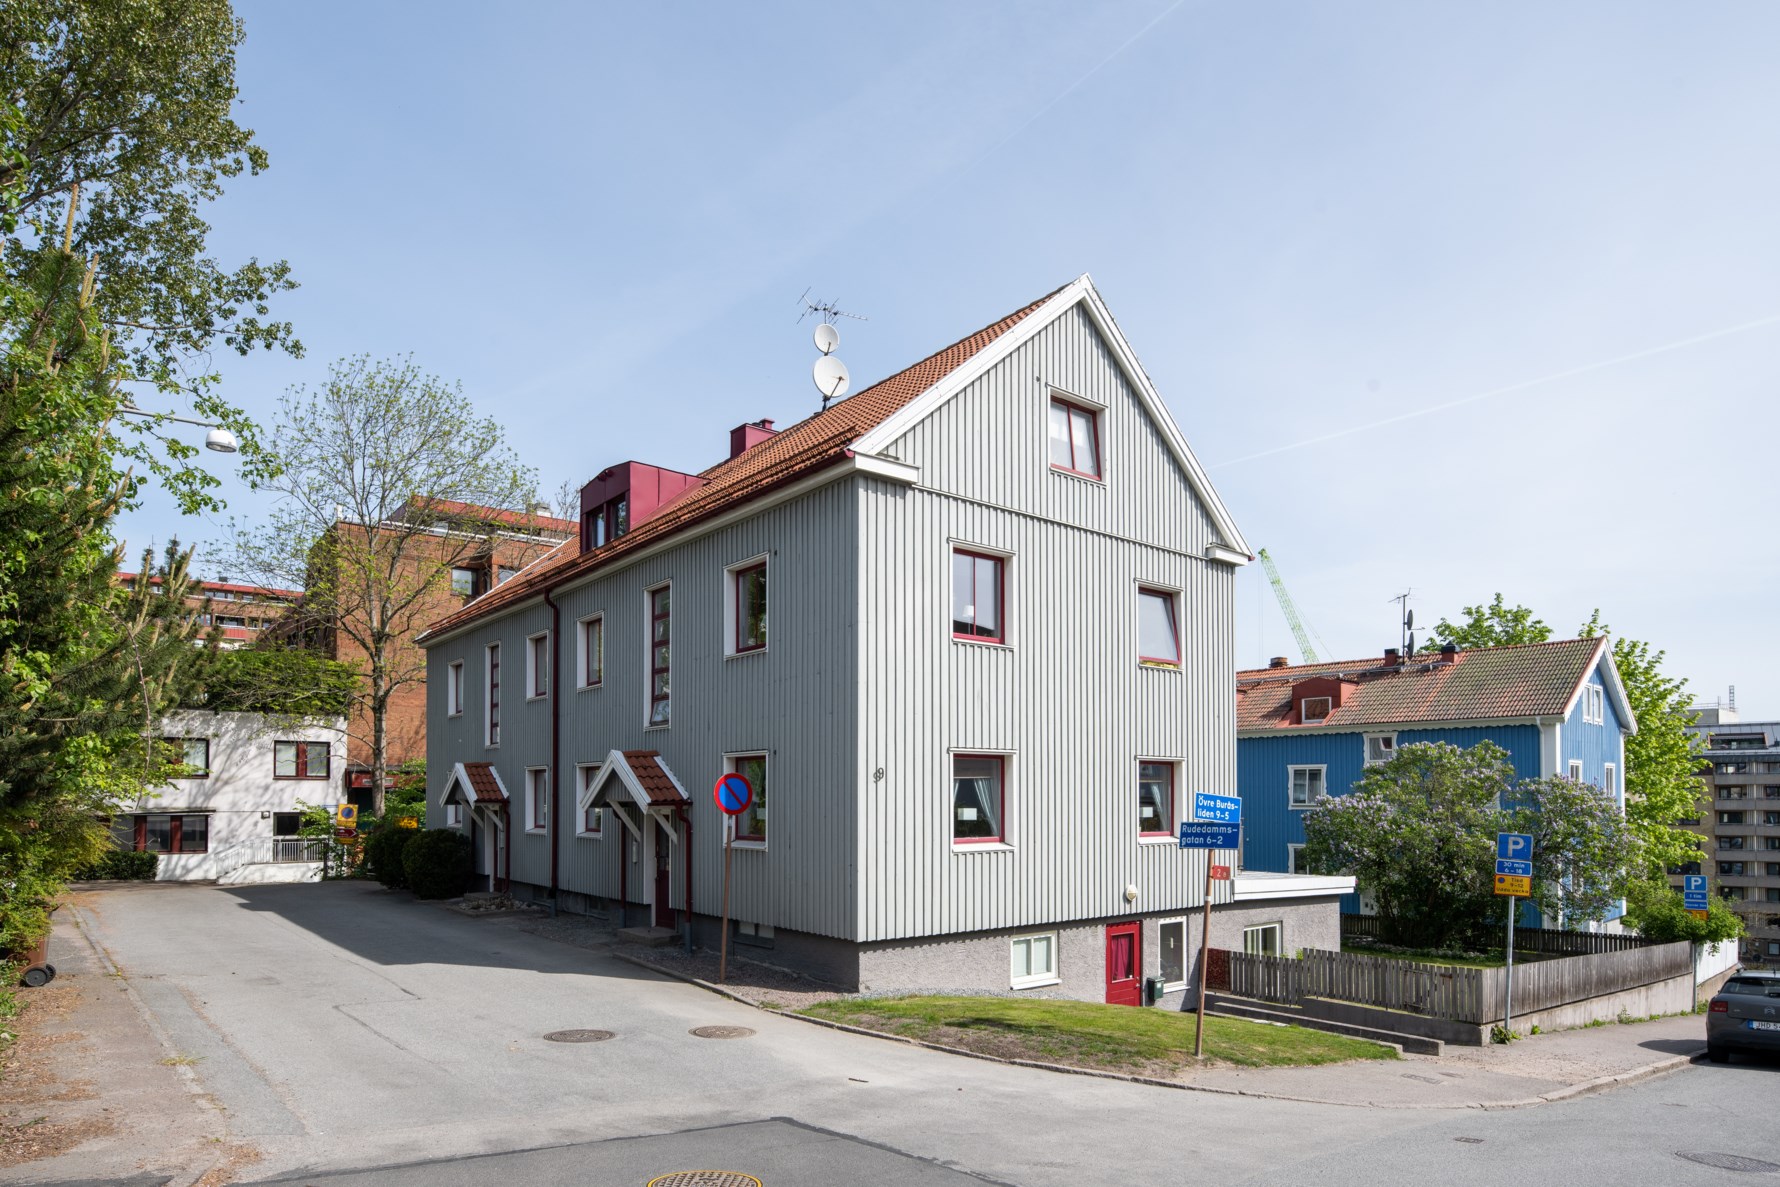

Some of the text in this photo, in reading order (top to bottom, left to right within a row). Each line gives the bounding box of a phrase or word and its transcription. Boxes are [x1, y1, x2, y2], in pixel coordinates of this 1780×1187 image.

[1198, 796, 1238, 808] Övre Burås-
[1198, 808, 1229, 820] liden 9-5
[1182, 825, 1238, 833] Rudedamms-
[1181, 835, 1223, 846] gatan 6-2
[1508, 836, 1524, 857] P
[1691, 877, 1702, 890] P
